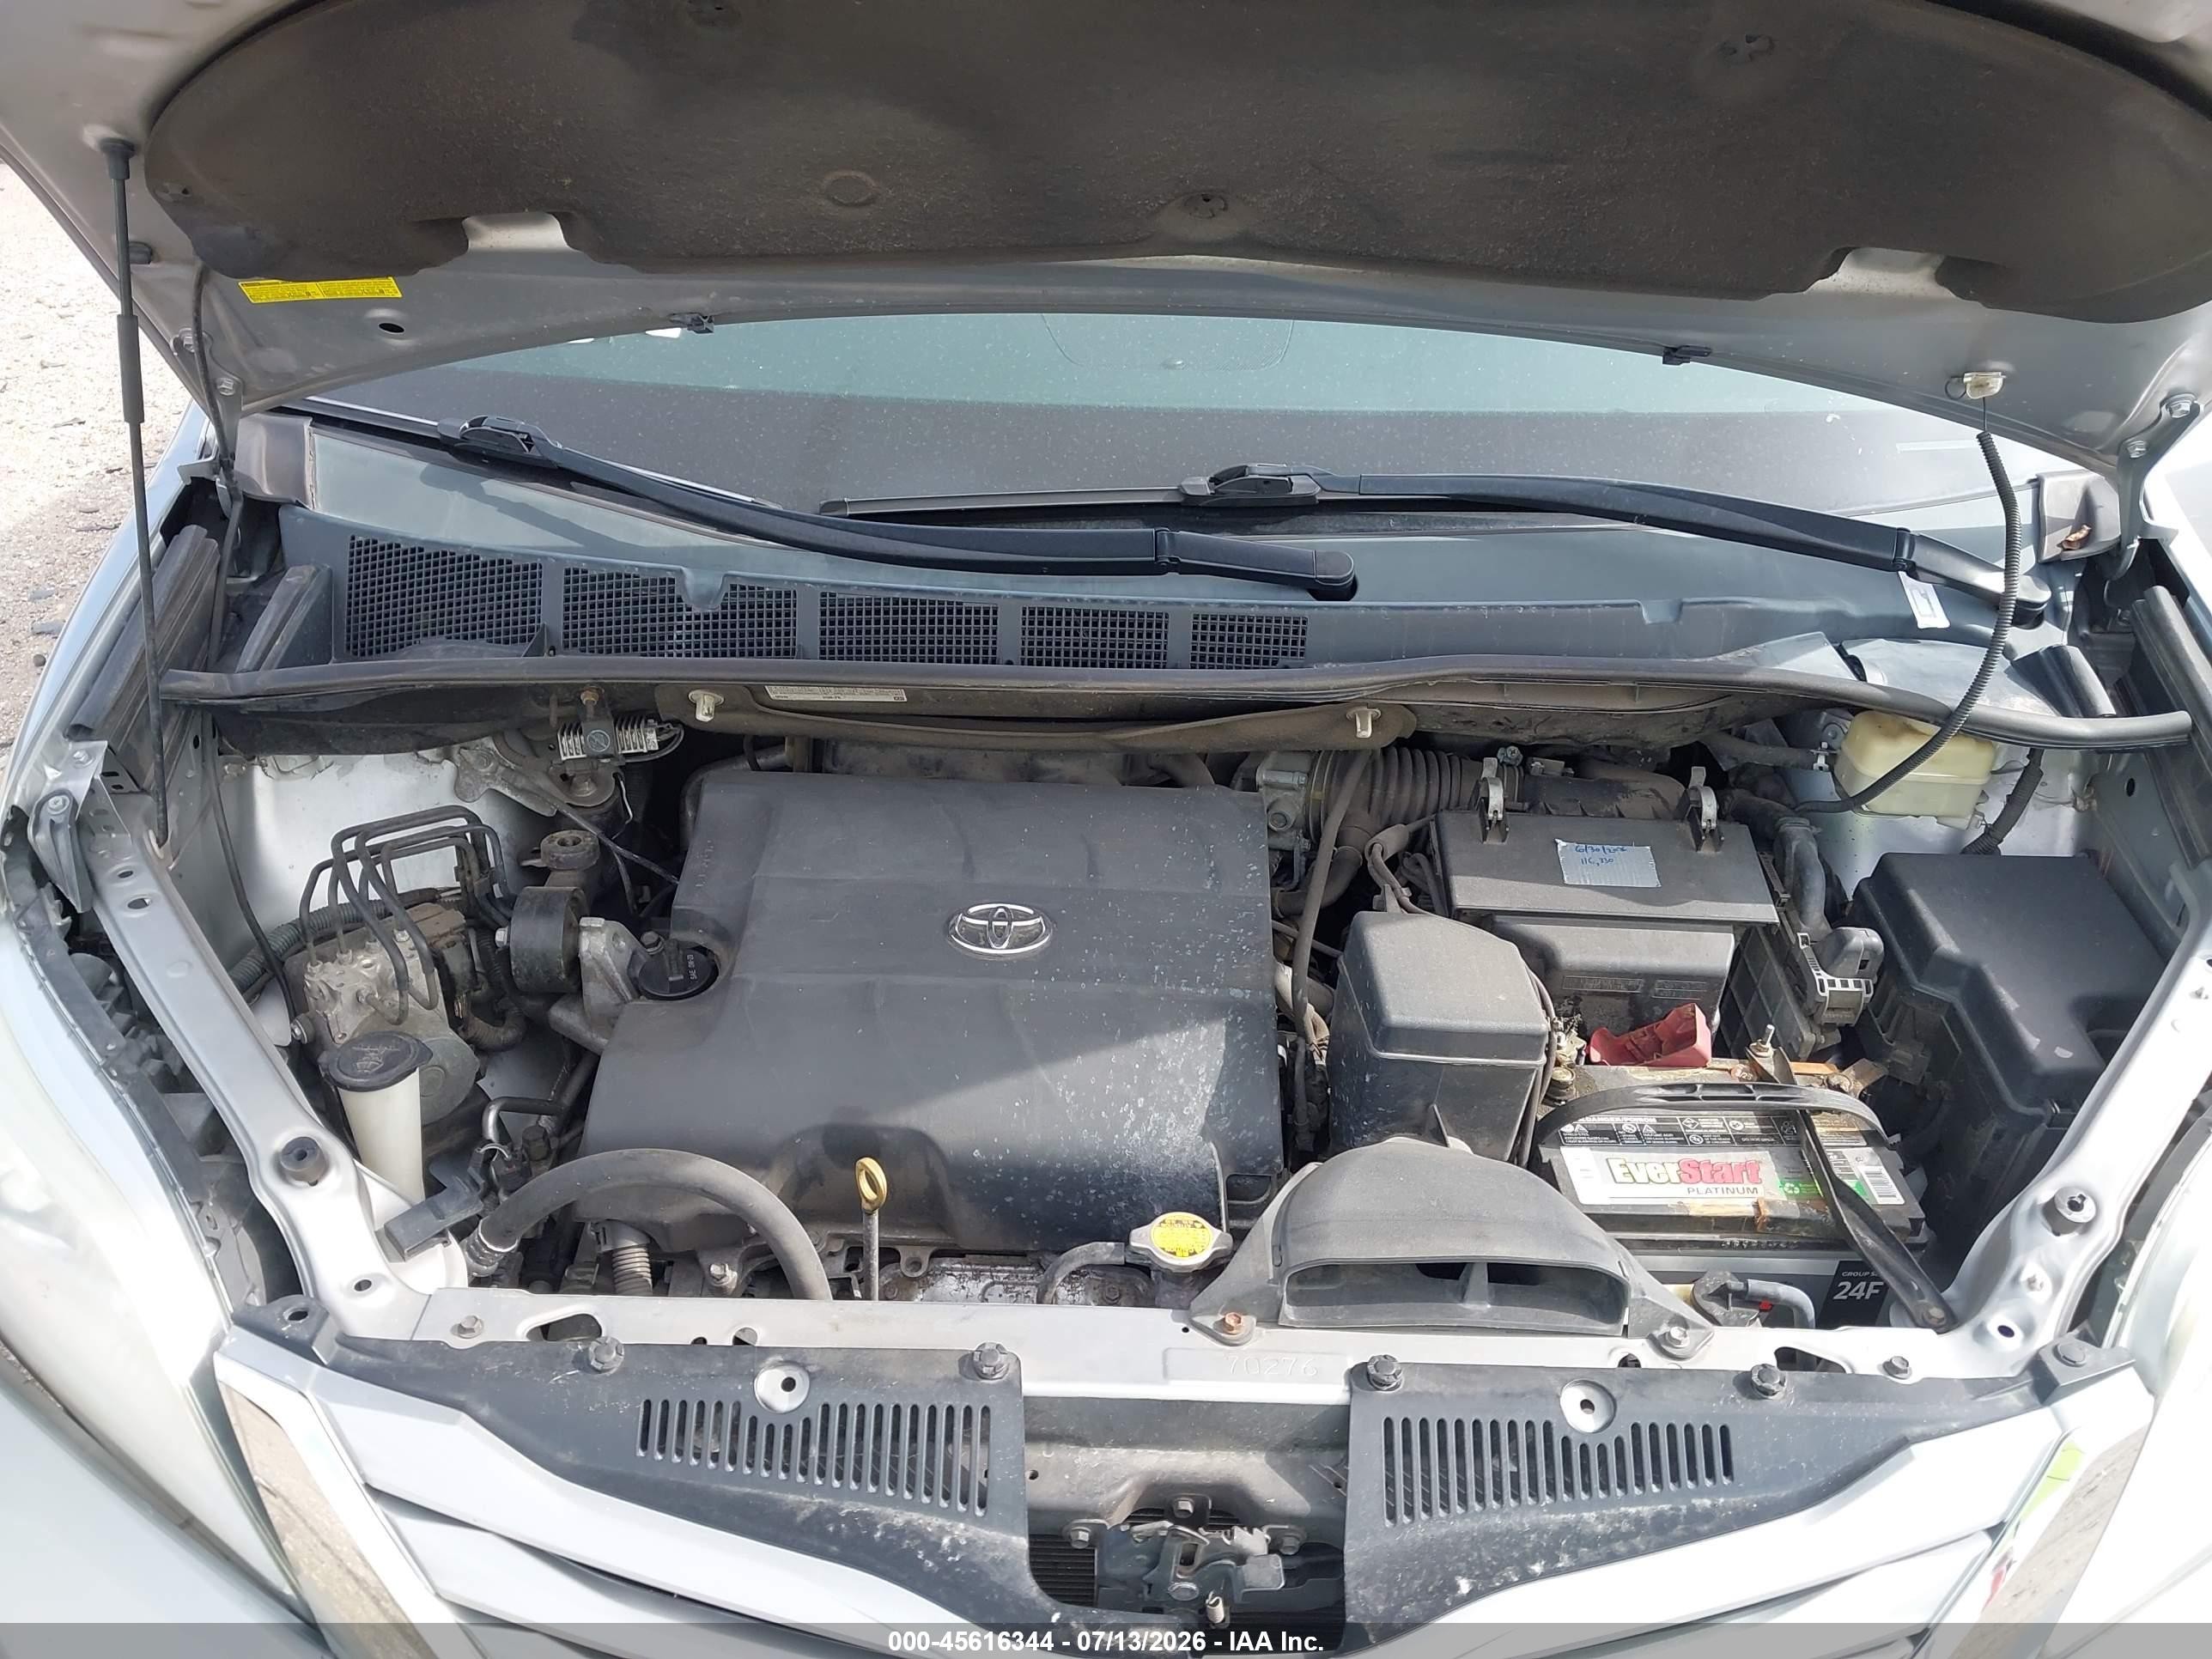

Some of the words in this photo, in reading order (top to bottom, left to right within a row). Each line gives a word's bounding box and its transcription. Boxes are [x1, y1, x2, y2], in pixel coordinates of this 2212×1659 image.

[1606, 1158, 1762, 1184] EverStart
[1687, 1187, 1759, 1195] PLATINUM
[1832, 1281, 1884, 1300] 24F
[1227, 1356, 1318, 1376] 70276
